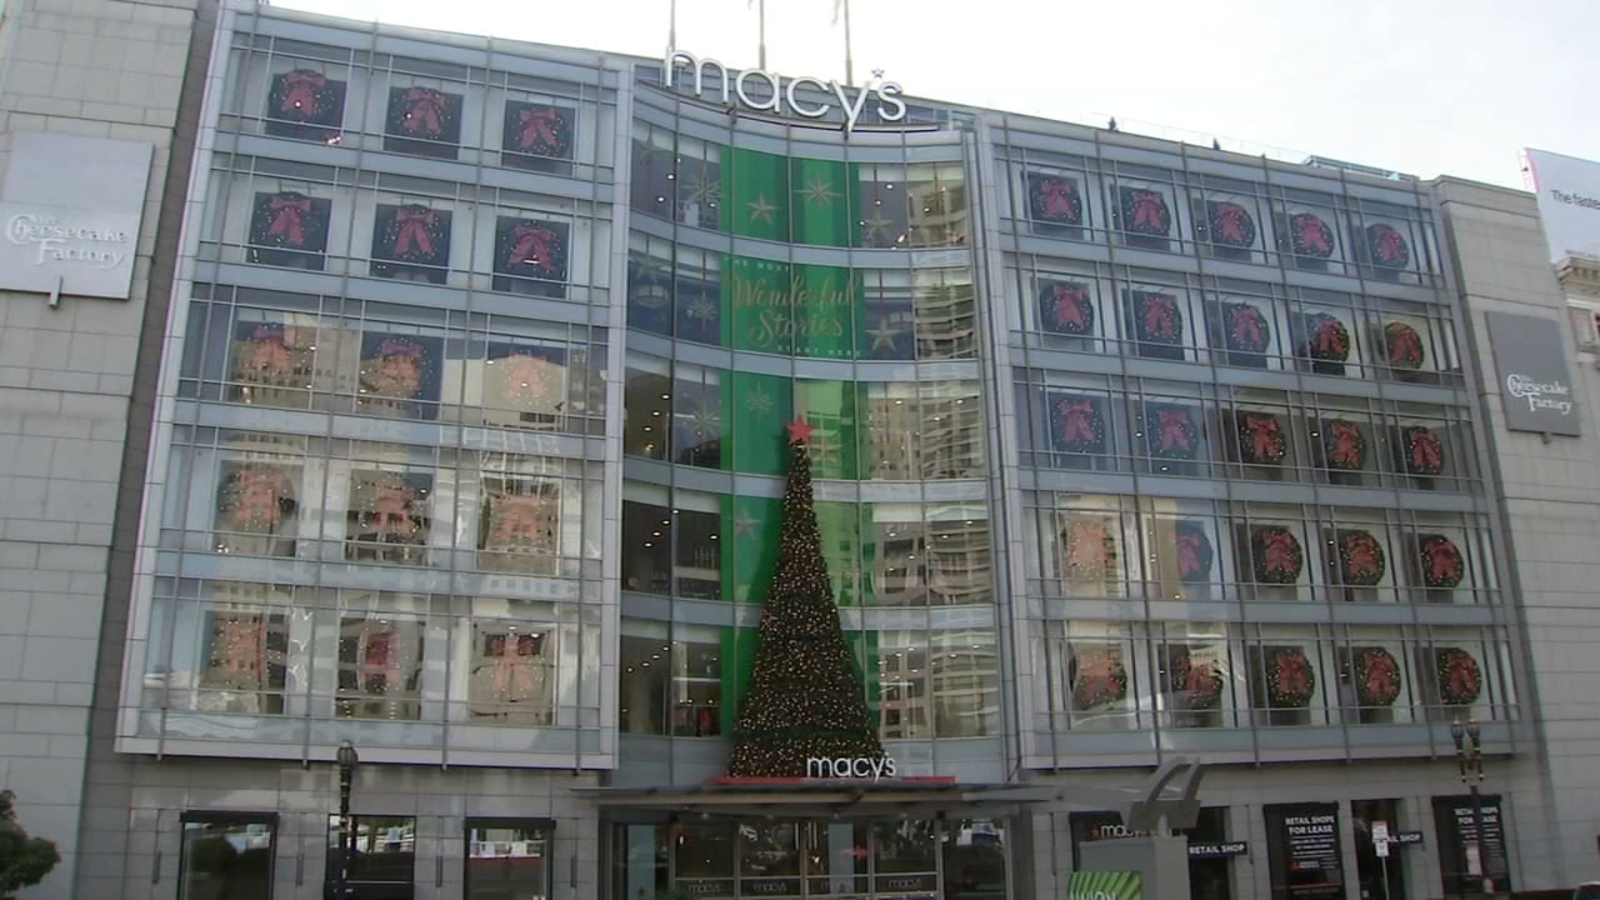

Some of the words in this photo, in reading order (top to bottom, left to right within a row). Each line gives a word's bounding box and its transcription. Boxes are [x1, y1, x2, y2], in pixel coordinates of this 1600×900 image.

[7, 214, 127, 244] Cheesecake
[35, 241, 125, 270] Factory
[1289, 826, 1306, 835] FOR
[1307, 825, 1333, 834] LEASE
[1189, 845, 1220, 855] RETAIL
[1221, 844, 1245, 853] SHOP
